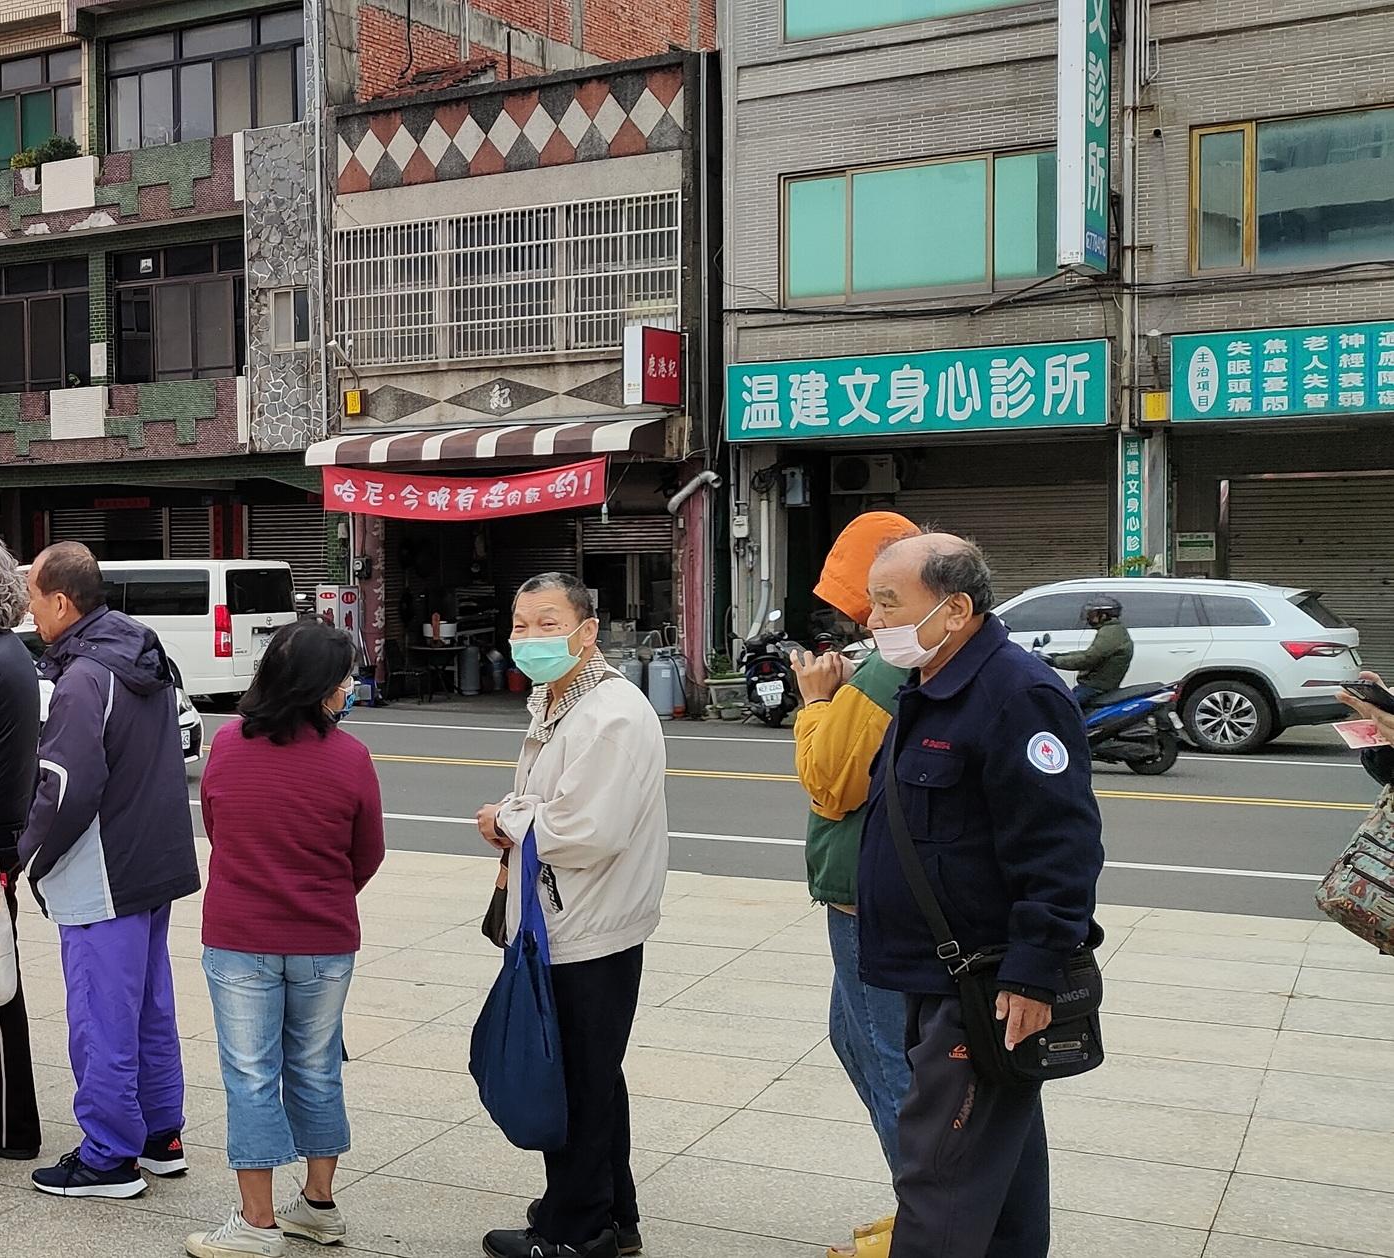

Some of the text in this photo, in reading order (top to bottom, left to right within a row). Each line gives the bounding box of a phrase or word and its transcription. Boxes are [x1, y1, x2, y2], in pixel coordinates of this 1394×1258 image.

[1196, 352, 1210, 407] 主治項目
[1227, 341, 1252, 413] 失眠頭痛
[1303, 335, 1329, 409] 老人失智
[1338, 333, 1365, 408] 神經衰弱
